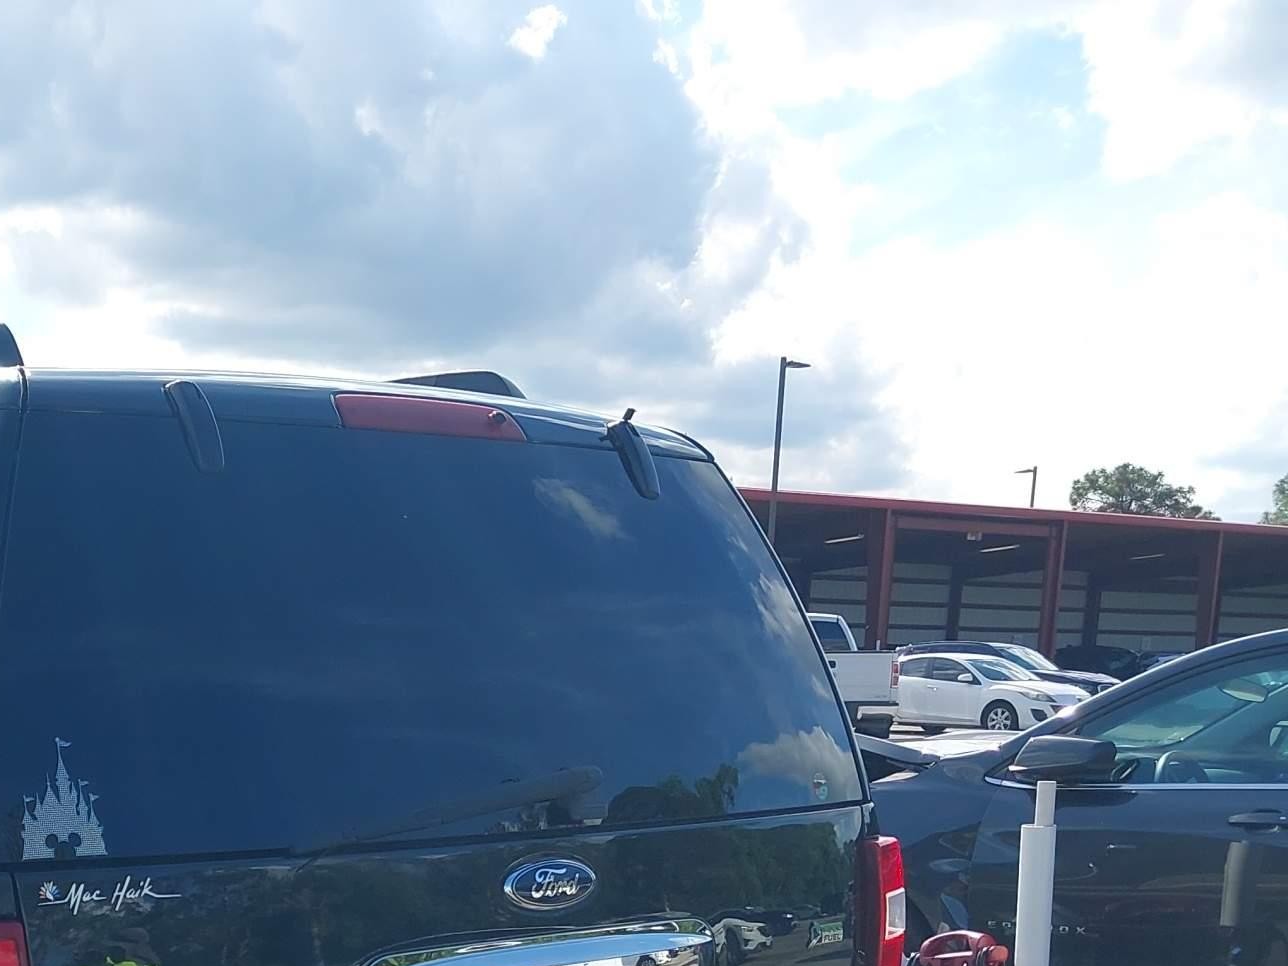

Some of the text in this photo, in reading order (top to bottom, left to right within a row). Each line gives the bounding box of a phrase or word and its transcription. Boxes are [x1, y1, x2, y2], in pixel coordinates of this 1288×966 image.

[38, 875, 182, 915] Mac Haik
[531, 867, 580, 899] Ford
